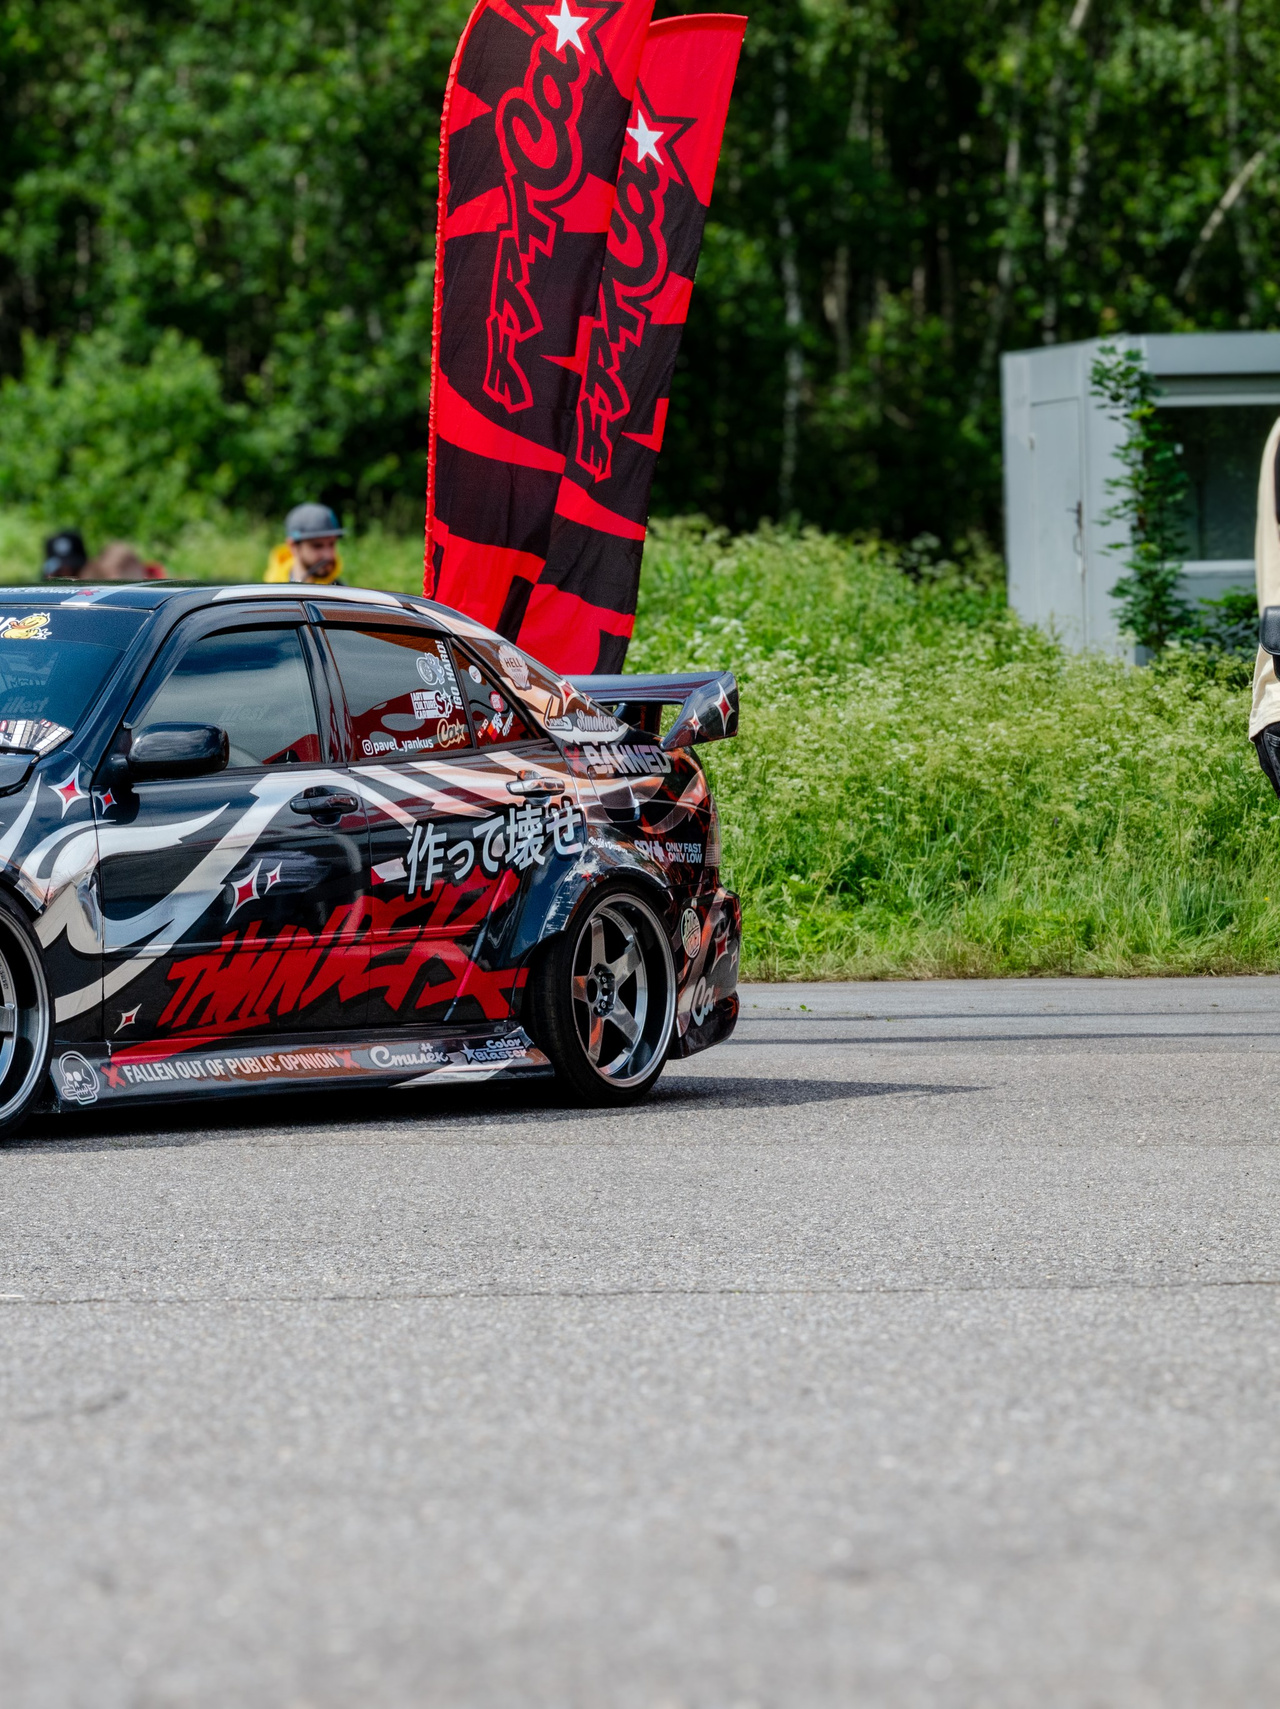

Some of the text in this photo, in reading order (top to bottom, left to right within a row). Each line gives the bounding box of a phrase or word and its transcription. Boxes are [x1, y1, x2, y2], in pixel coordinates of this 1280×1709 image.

[504, 657, 523, 668] HELL
[575, 708, 619, 732] Smokers
[583, 744, 671, 775] BANNED
[407, 800, 584, 895] 作って壊せ
[665, 842, 683, 853] ONLY
[684, 843, 702, 854] FAST
[668, 852, 703, 864] ONLY LOW
[485, 1038, 521, 1050] Color
[474, 1048, 527, 1062] Blaster
[122, 1052, 340, 1084] FALLEN OUT OF PUBLIC OPINION
